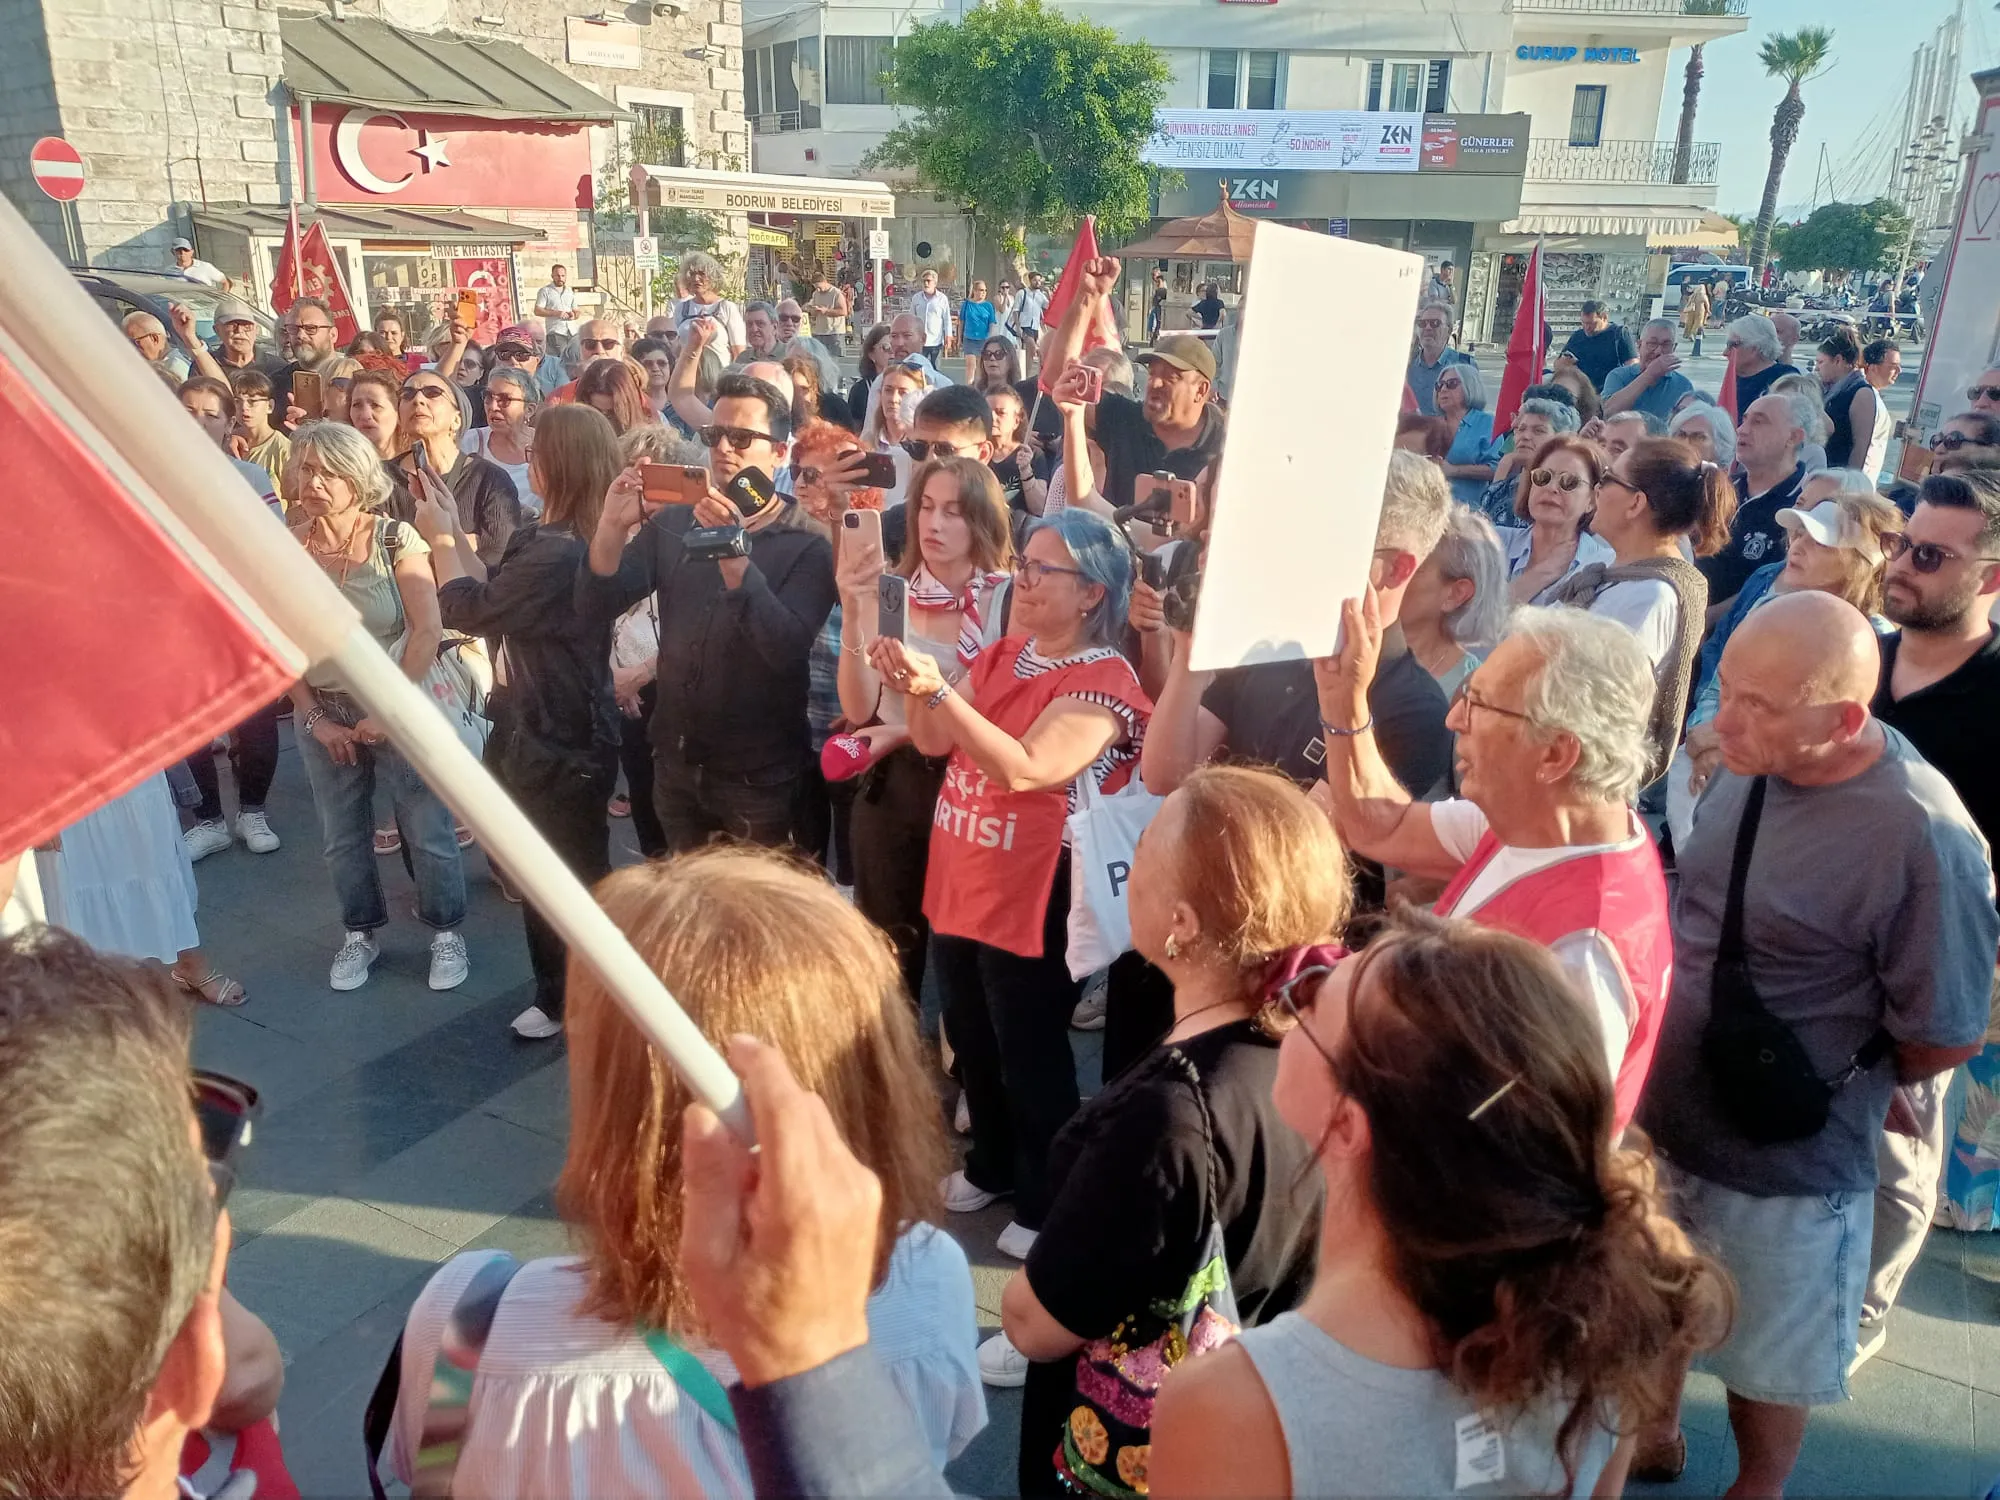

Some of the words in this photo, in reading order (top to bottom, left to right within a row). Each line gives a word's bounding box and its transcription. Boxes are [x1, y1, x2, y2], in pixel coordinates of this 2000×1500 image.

[1516, 45, 1577, 62] GURUP
[1584, 47, 1641, 63] HOTEL
[1381, 125, 1412, 144] ZEN
[1460, 136, 1515, 147] GÜNERLER
[1213, 141, 1245, 159] OLMAZ
[1230, 178, 1279, 200] ZEN
[726, 194, 776, 209] BODRUM
[782, 196, 842, 212] BELEDİYESİ
